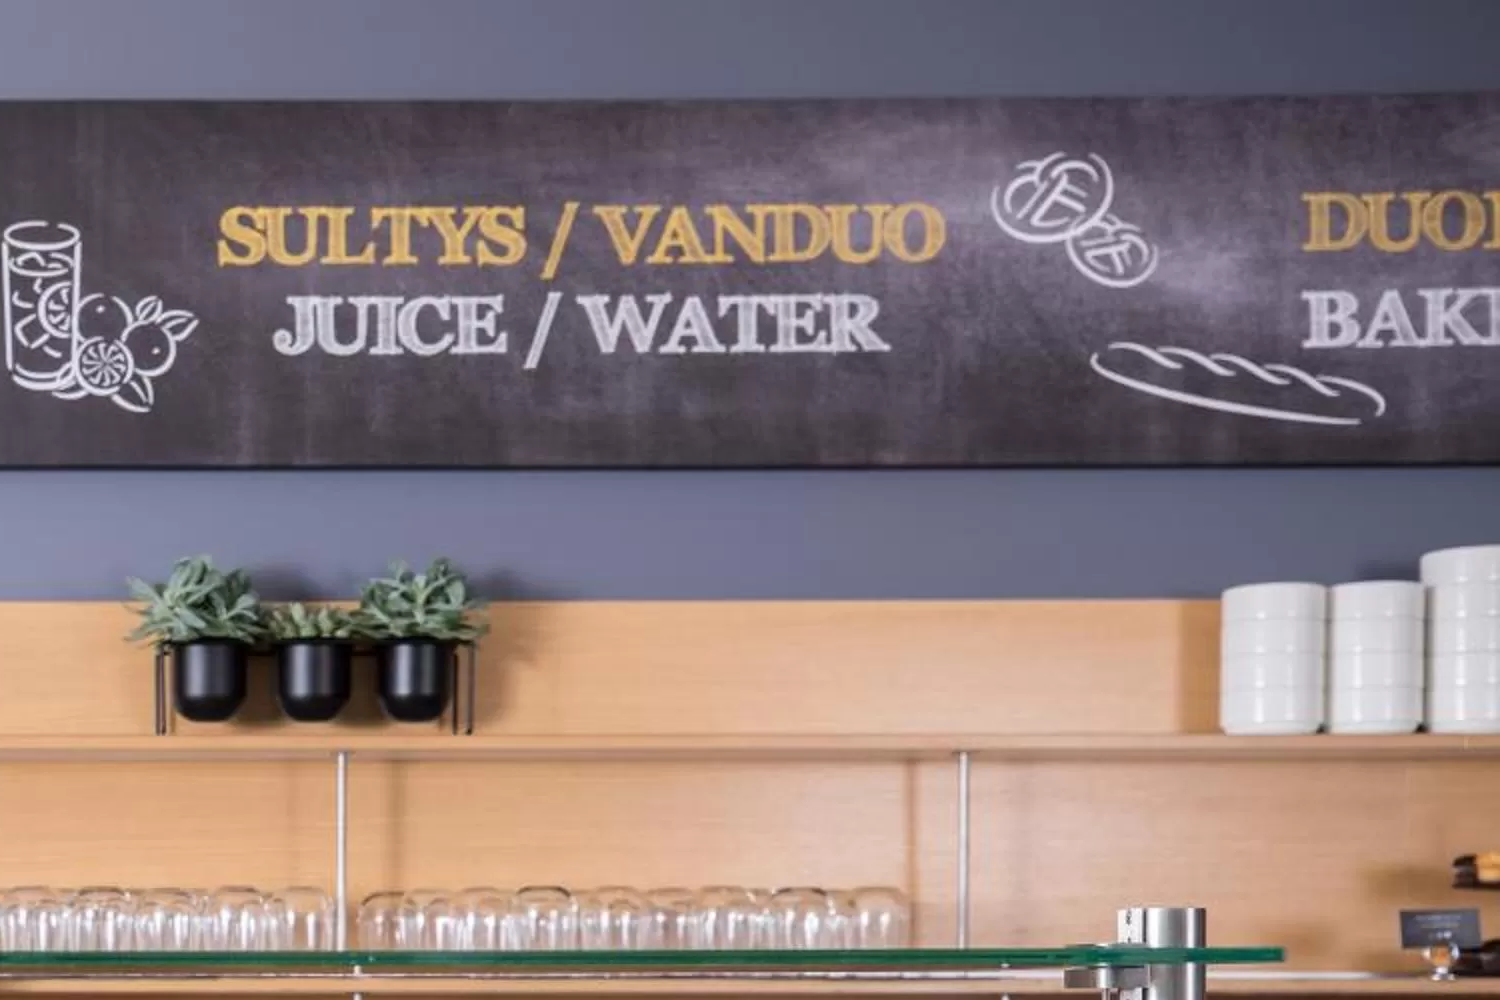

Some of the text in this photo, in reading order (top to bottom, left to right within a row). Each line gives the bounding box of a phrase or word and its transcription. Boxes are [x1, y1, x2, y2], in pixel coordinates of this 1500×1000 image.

[217, 201, 947, 281] SULTYS / VANDUO
[272, 291, 891, 370] JUICE / WATER
